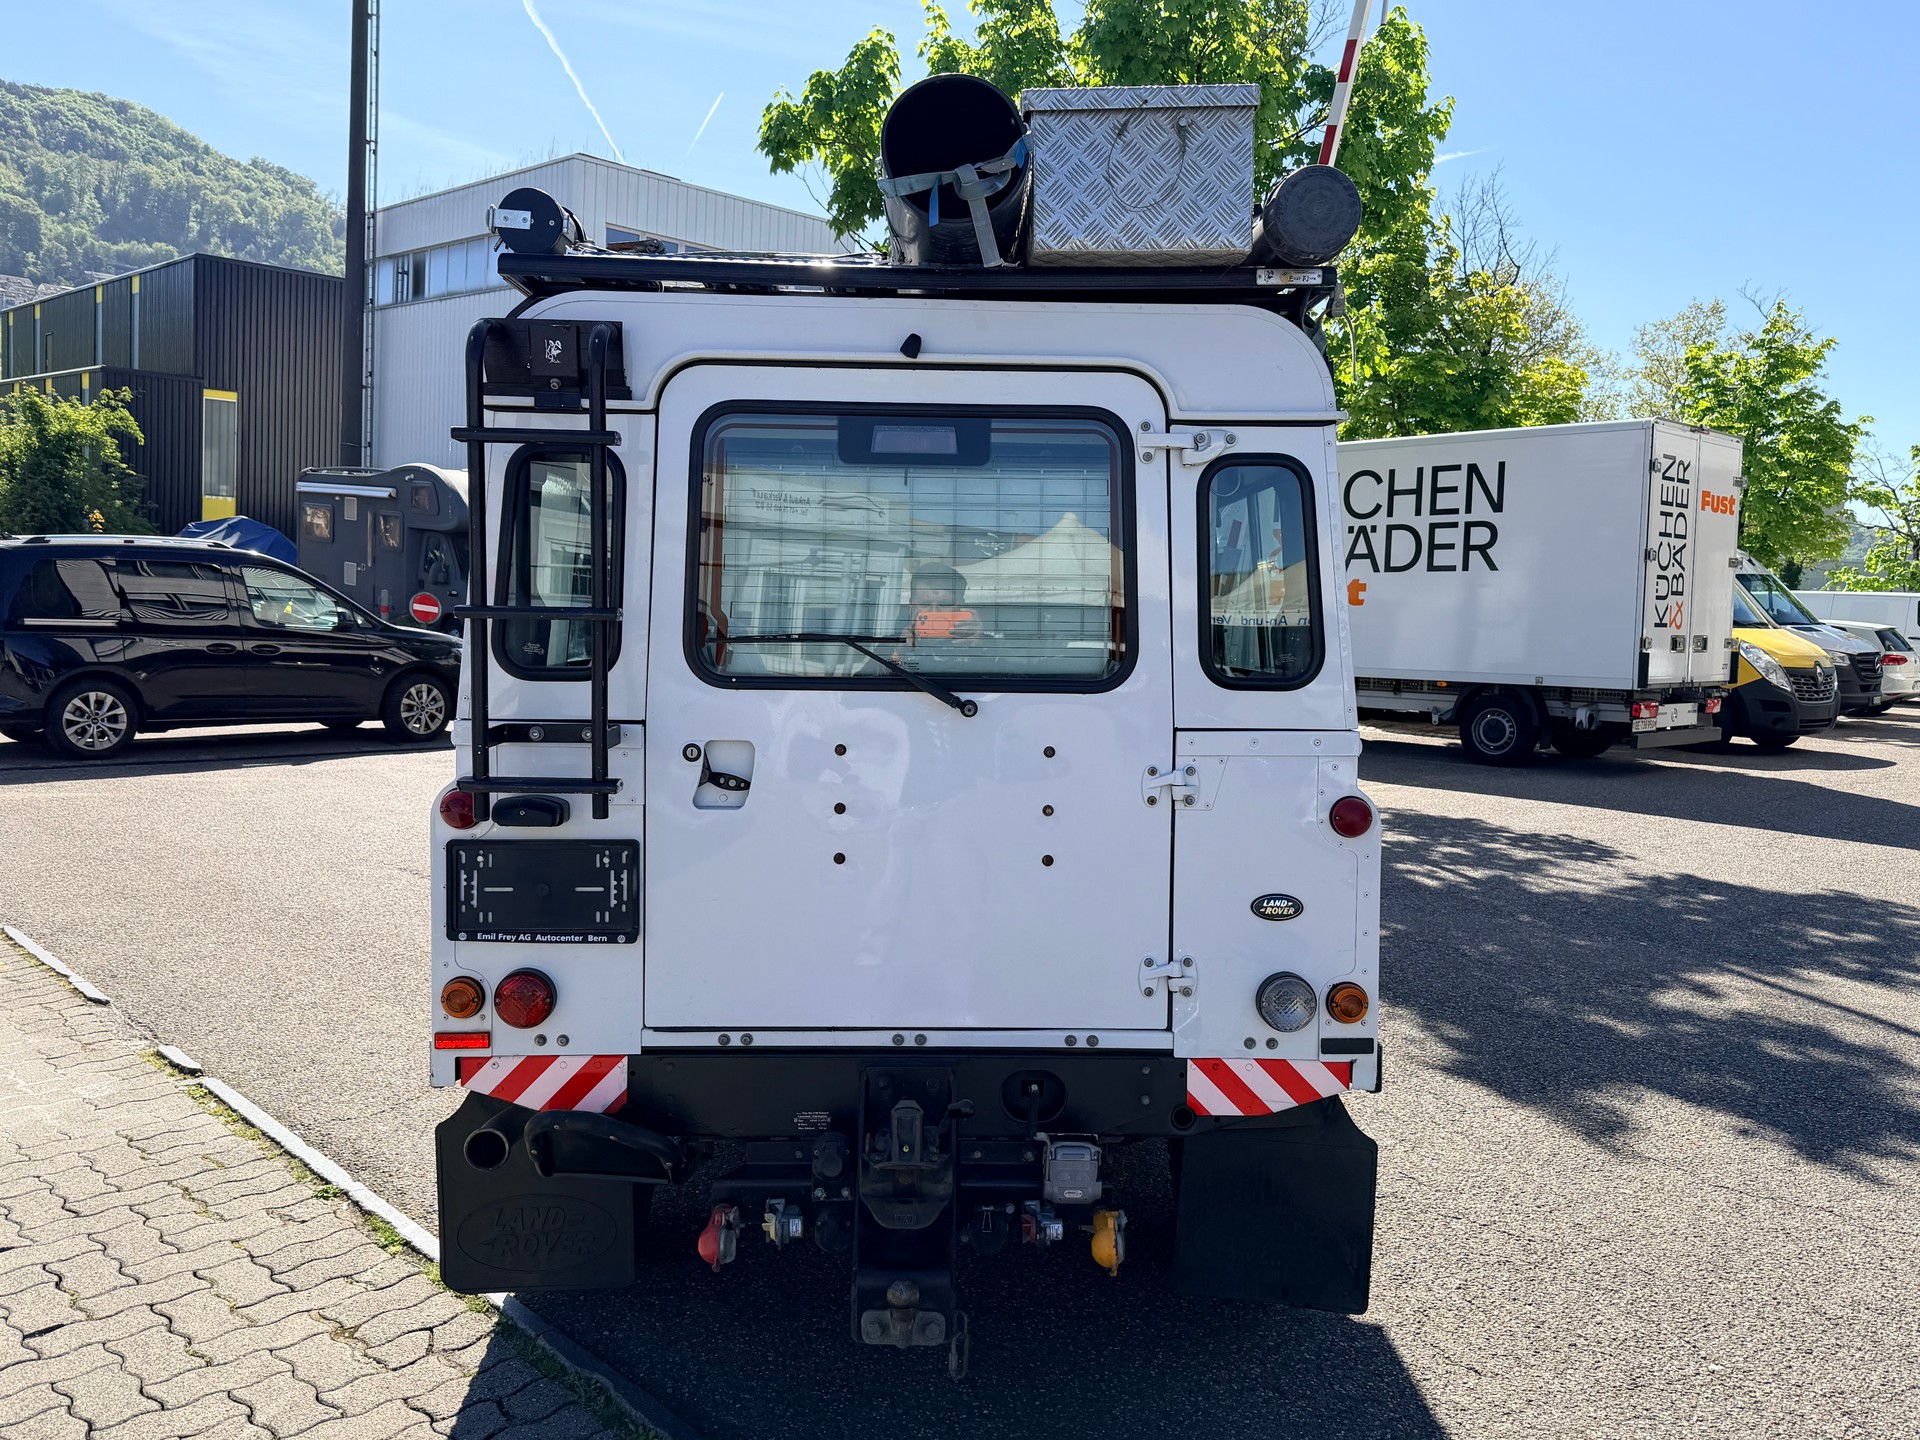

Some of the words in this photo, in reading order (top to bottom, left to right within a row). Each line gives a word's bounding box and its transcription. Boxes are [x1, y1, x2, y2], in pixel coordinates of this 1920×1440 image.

[1701, 490, 1736, 516] Fust
[1654, 453, 1676, 628] KÜCHEN
[1670, 459, 1691, 596] BÄDER
[1669, 601, 1683, 630] &
[1263, 899, 1288, 907] LAND
[1265, 907, 1295, 915] ROVER
[498, 933, 517, 942] Frey
[535, 934, 583, 942] Autocenter
[587, 934, 608, 942] Bern
[494, 1207, 567, 1231] LAND
[499, 1230, 597, 1256] ROVER
